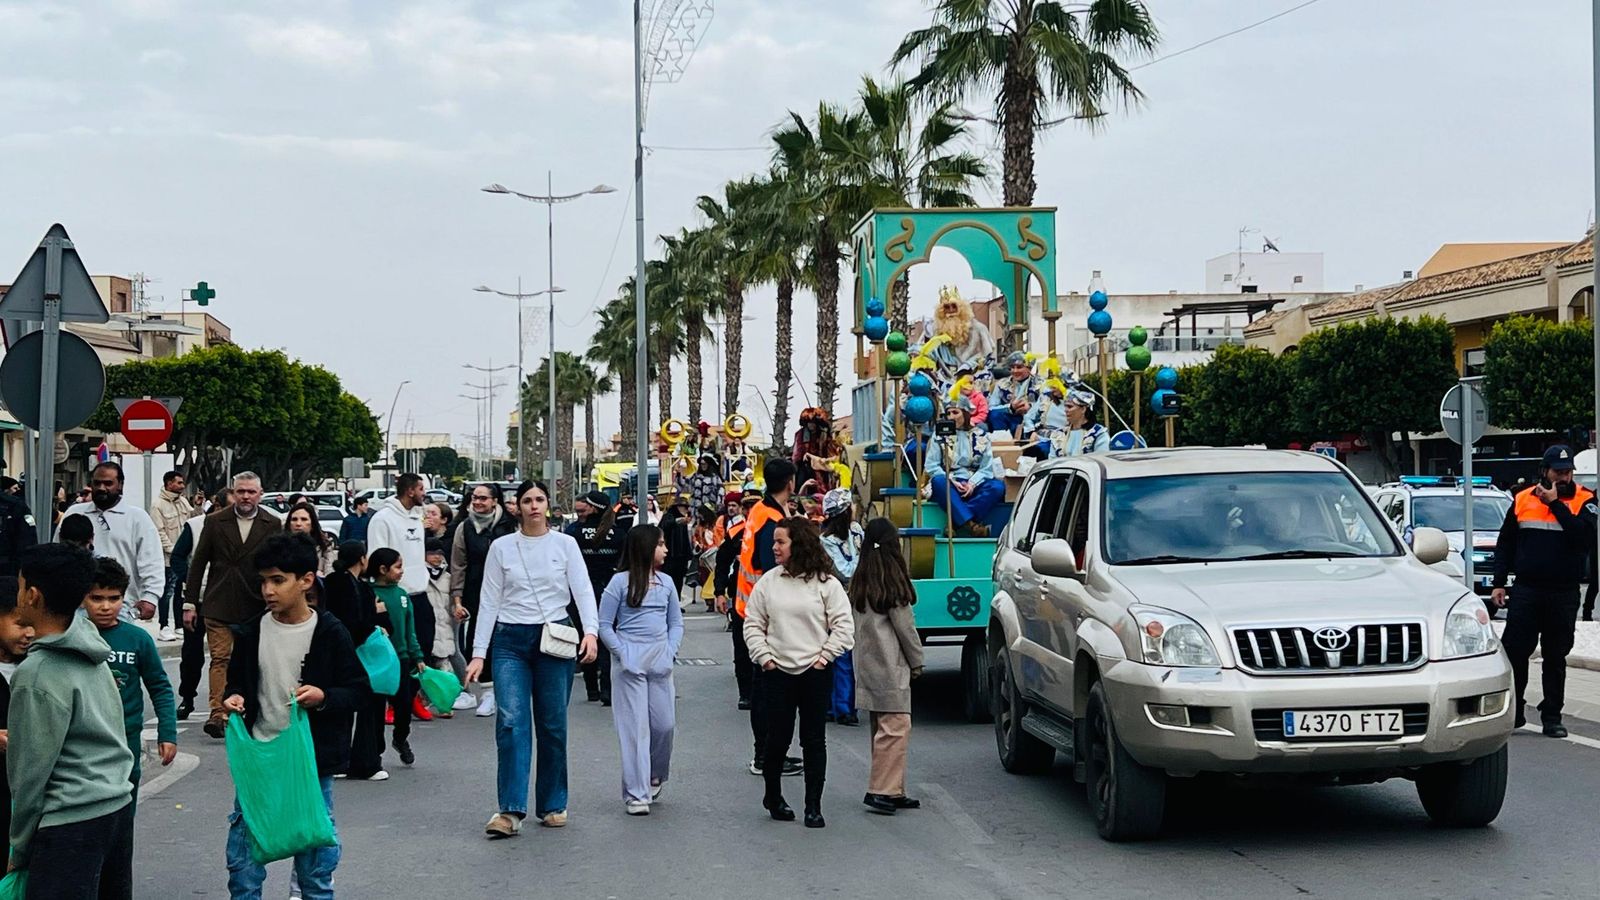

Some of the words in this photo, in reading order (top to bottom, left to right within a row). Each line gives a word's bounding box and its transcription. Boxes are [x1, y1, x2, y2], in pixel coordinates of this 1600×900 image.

[582, 527, 615, 535] POLA
[107, 651, 136, 665] STE
[1299, 713, 1352, 733] 4370
[1361, 712, 1400, 732] FTZ
